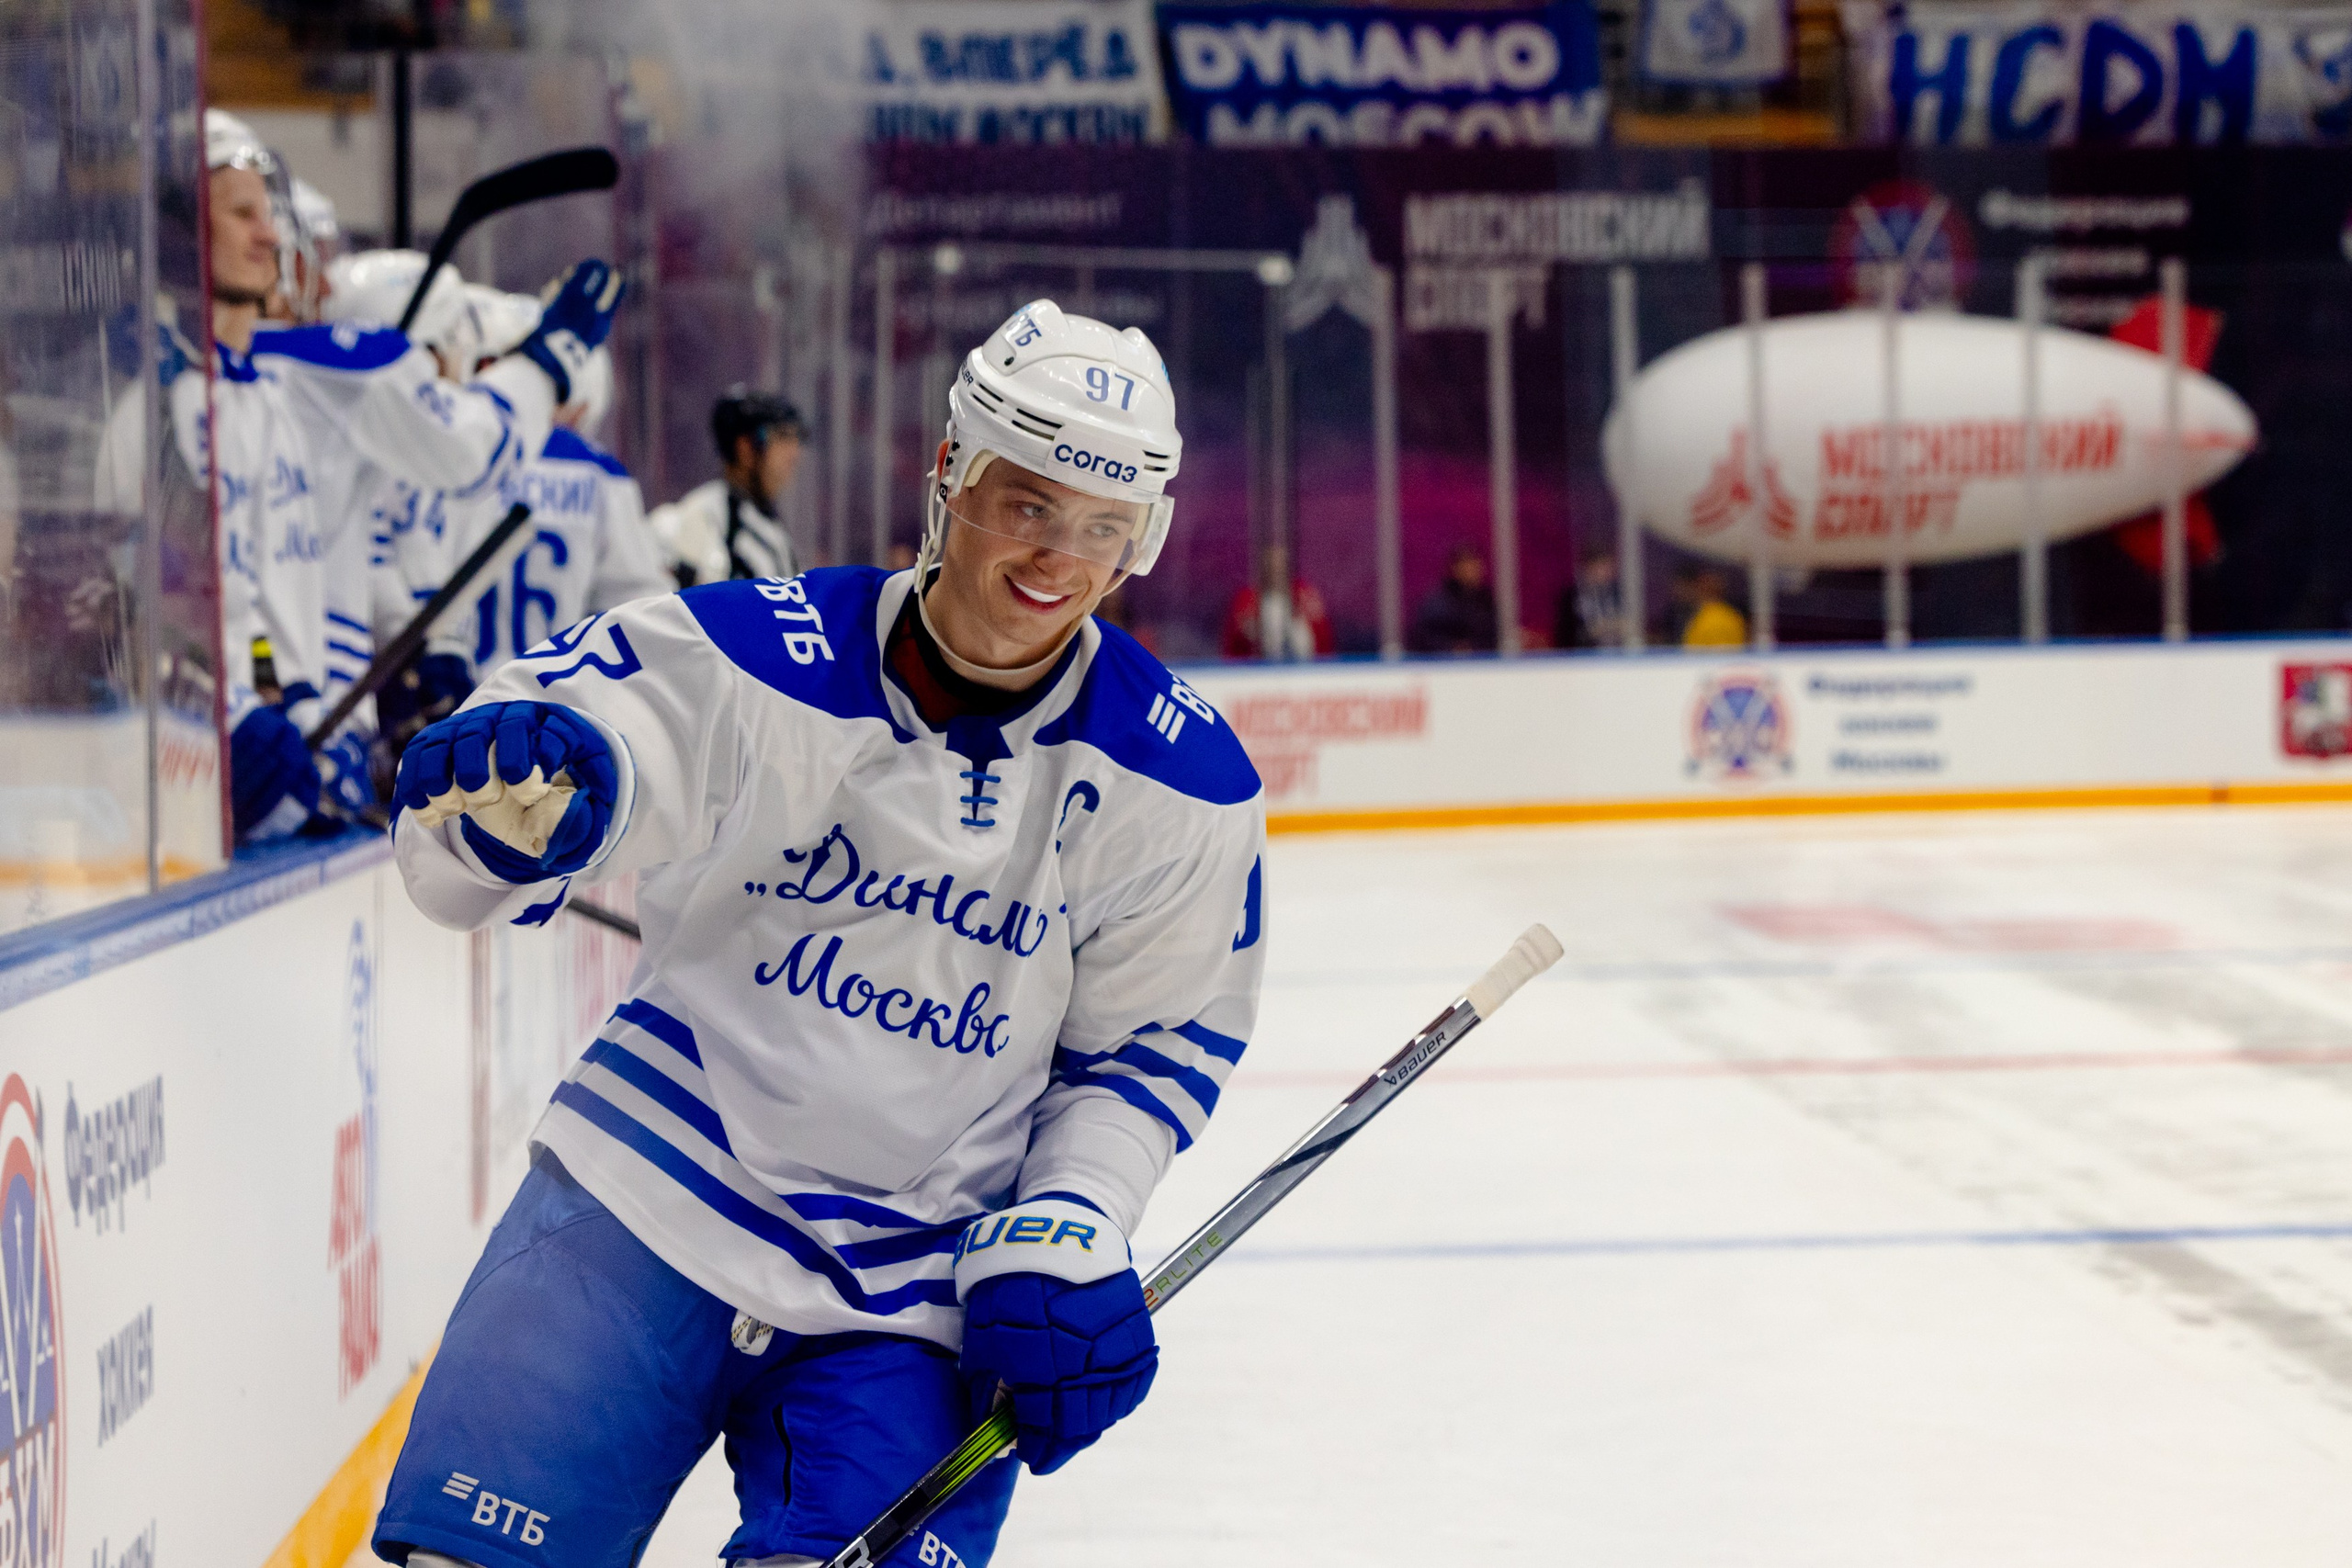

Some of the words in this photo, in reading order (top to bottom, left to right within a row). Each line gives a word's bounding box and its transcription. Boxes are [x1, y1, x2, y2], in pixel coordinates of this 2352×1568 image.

[1170, 18, 1561, 93] DYNAMO
[1085, 366, 1136, 412] 97
[753, 573, 836, 666] ВТБ
[471, 1488, 551, 1547] ВТБ
